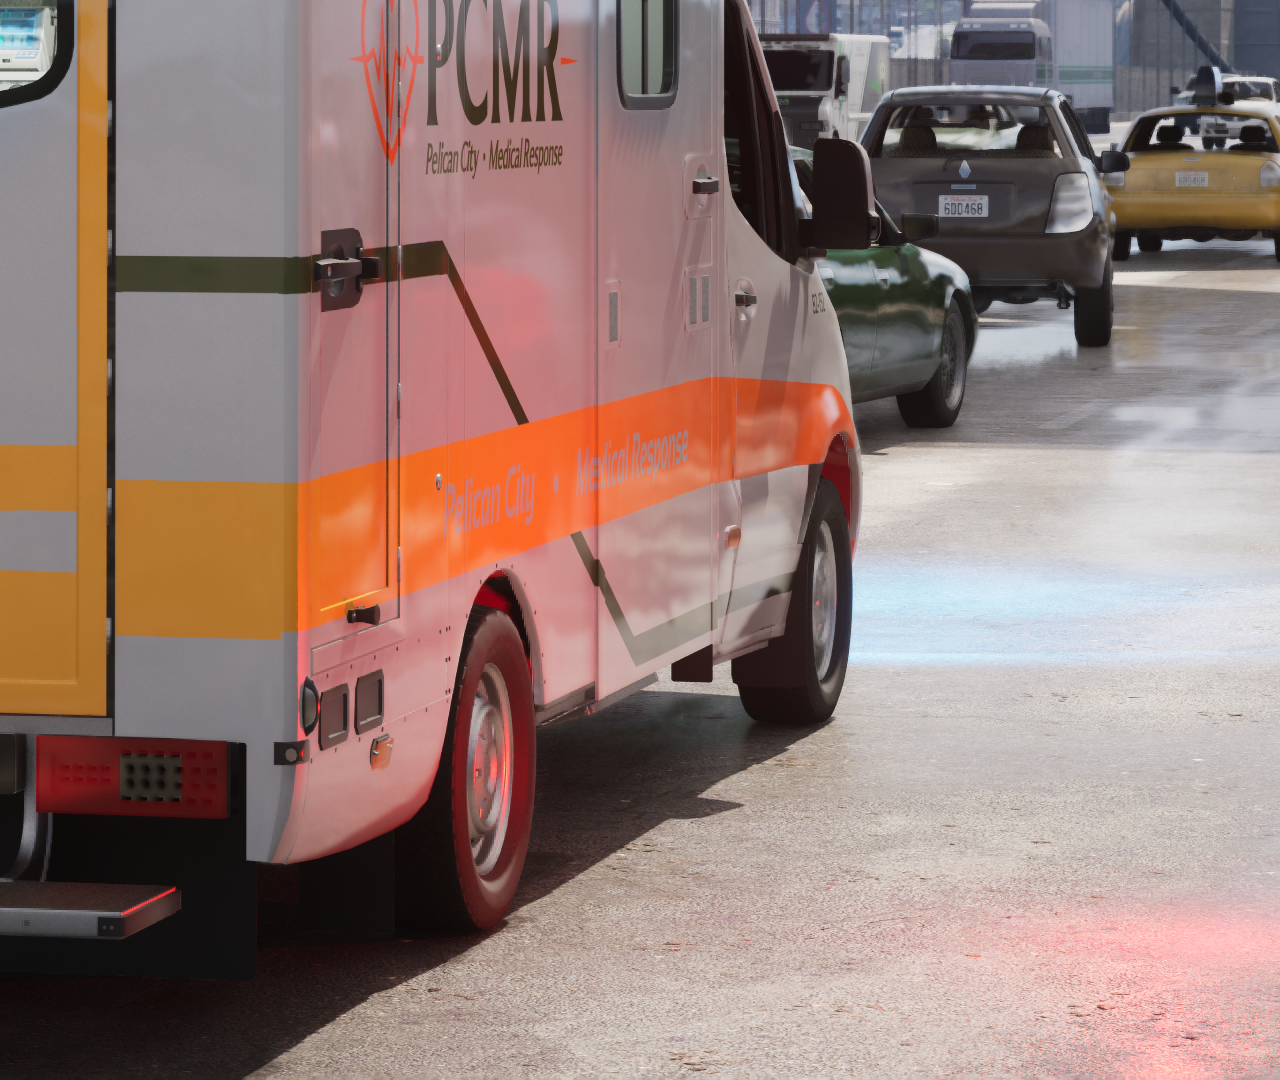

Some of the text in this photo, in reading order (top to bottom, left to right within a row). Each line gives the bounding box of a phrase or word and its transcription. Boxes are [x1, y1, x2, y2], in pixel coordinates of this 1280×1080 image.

[426, 138, 563, 180] Pelican City Medical Response
[944, 203, 983, 215] 6DD468
[443, 429, 689, 540] Pelican City Medical Response
